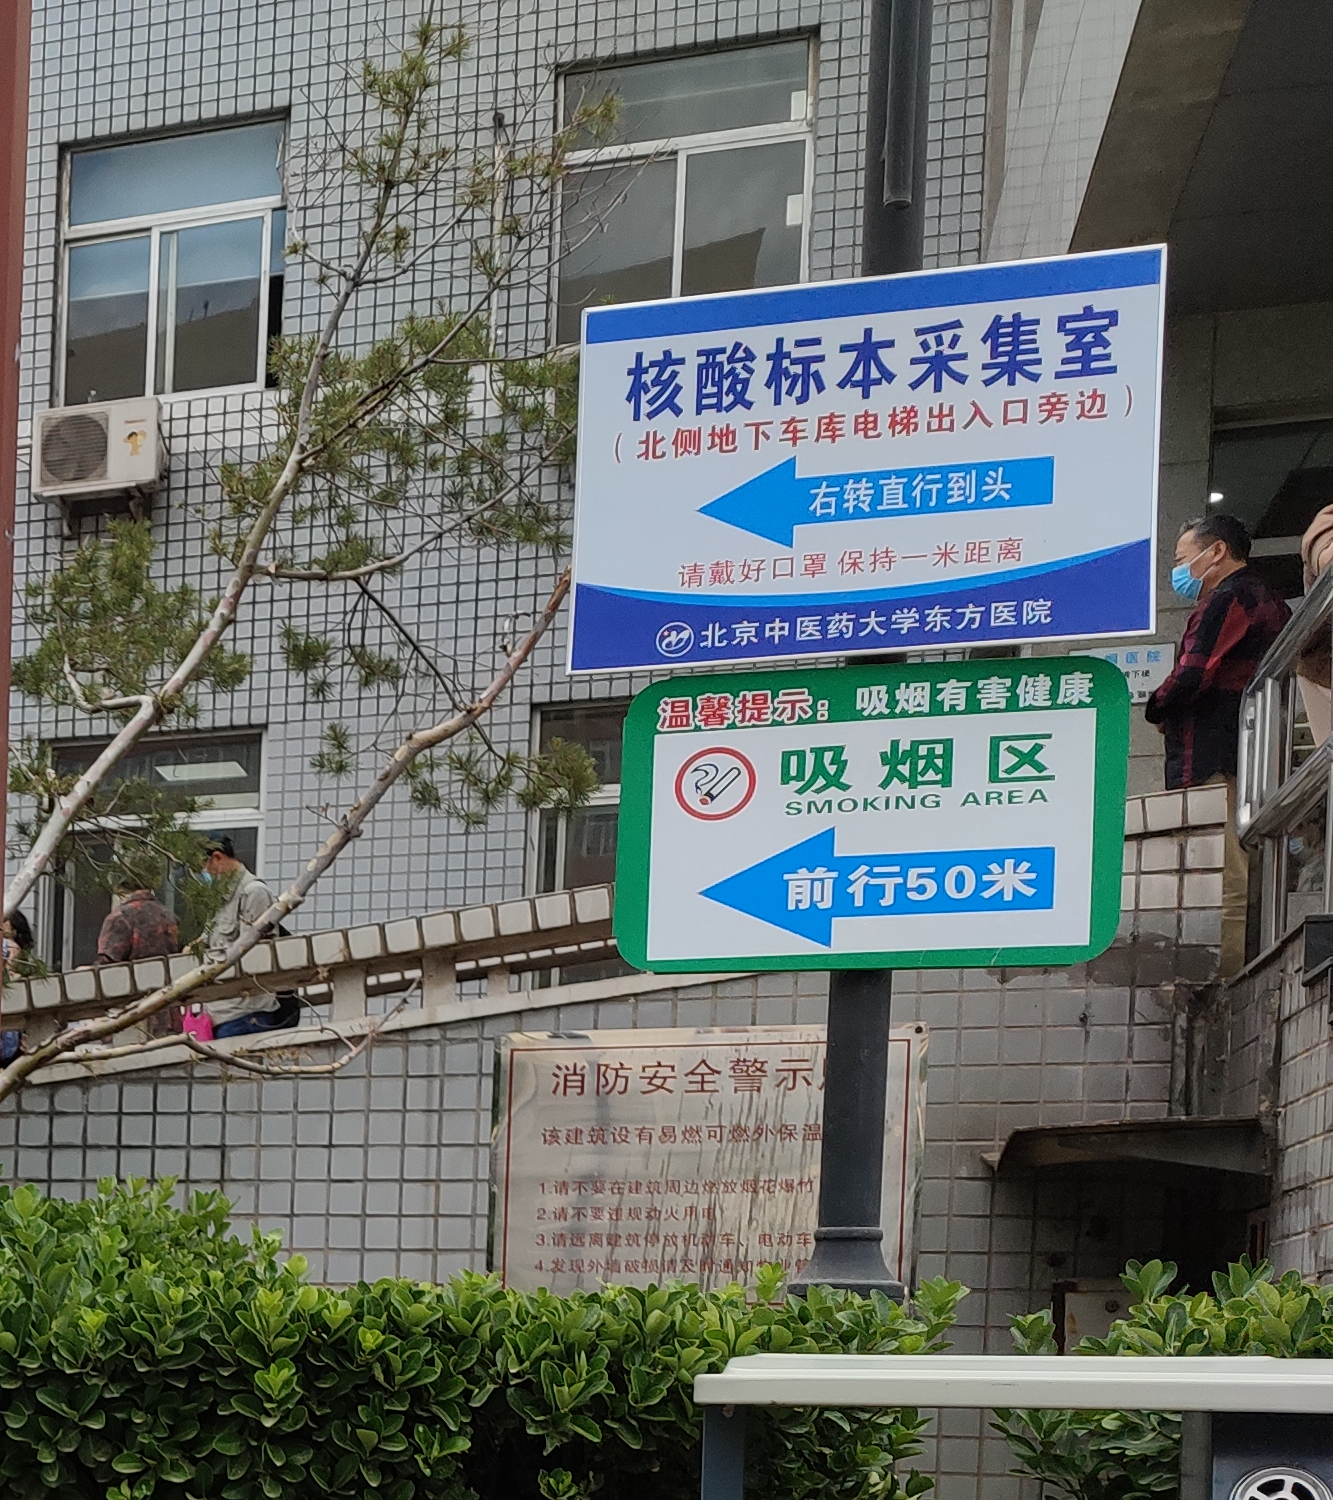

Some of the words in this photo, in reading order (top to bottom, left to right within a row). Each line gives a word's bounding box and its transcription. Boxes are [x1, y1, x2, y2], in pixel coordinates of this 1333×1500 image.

[625, 304, 1121, 422] 核酸标本采集室
[808, 467, 1013, 518] 右转直行到头
[677, 550, 829, 589] 请戴好口罩
[837, 536, 1025, 577] 保持一米距离
[700, 597, 1053, 650] 北京中医药大学东方医院
[855, 671, 1095, 718] 吸烟有害健康
[779, 732, 1056, 796] 吸烟区
[784, 793, 942, 818] SMOKING
[960, 788, 1049, 808] AREA
[782, 858, 1038, 912] 前行50米
[550, 1057, 825, 1097] 消防安全警示
[541, 1123, 823, 1147] 该建筑设有易燃可燃外保温
